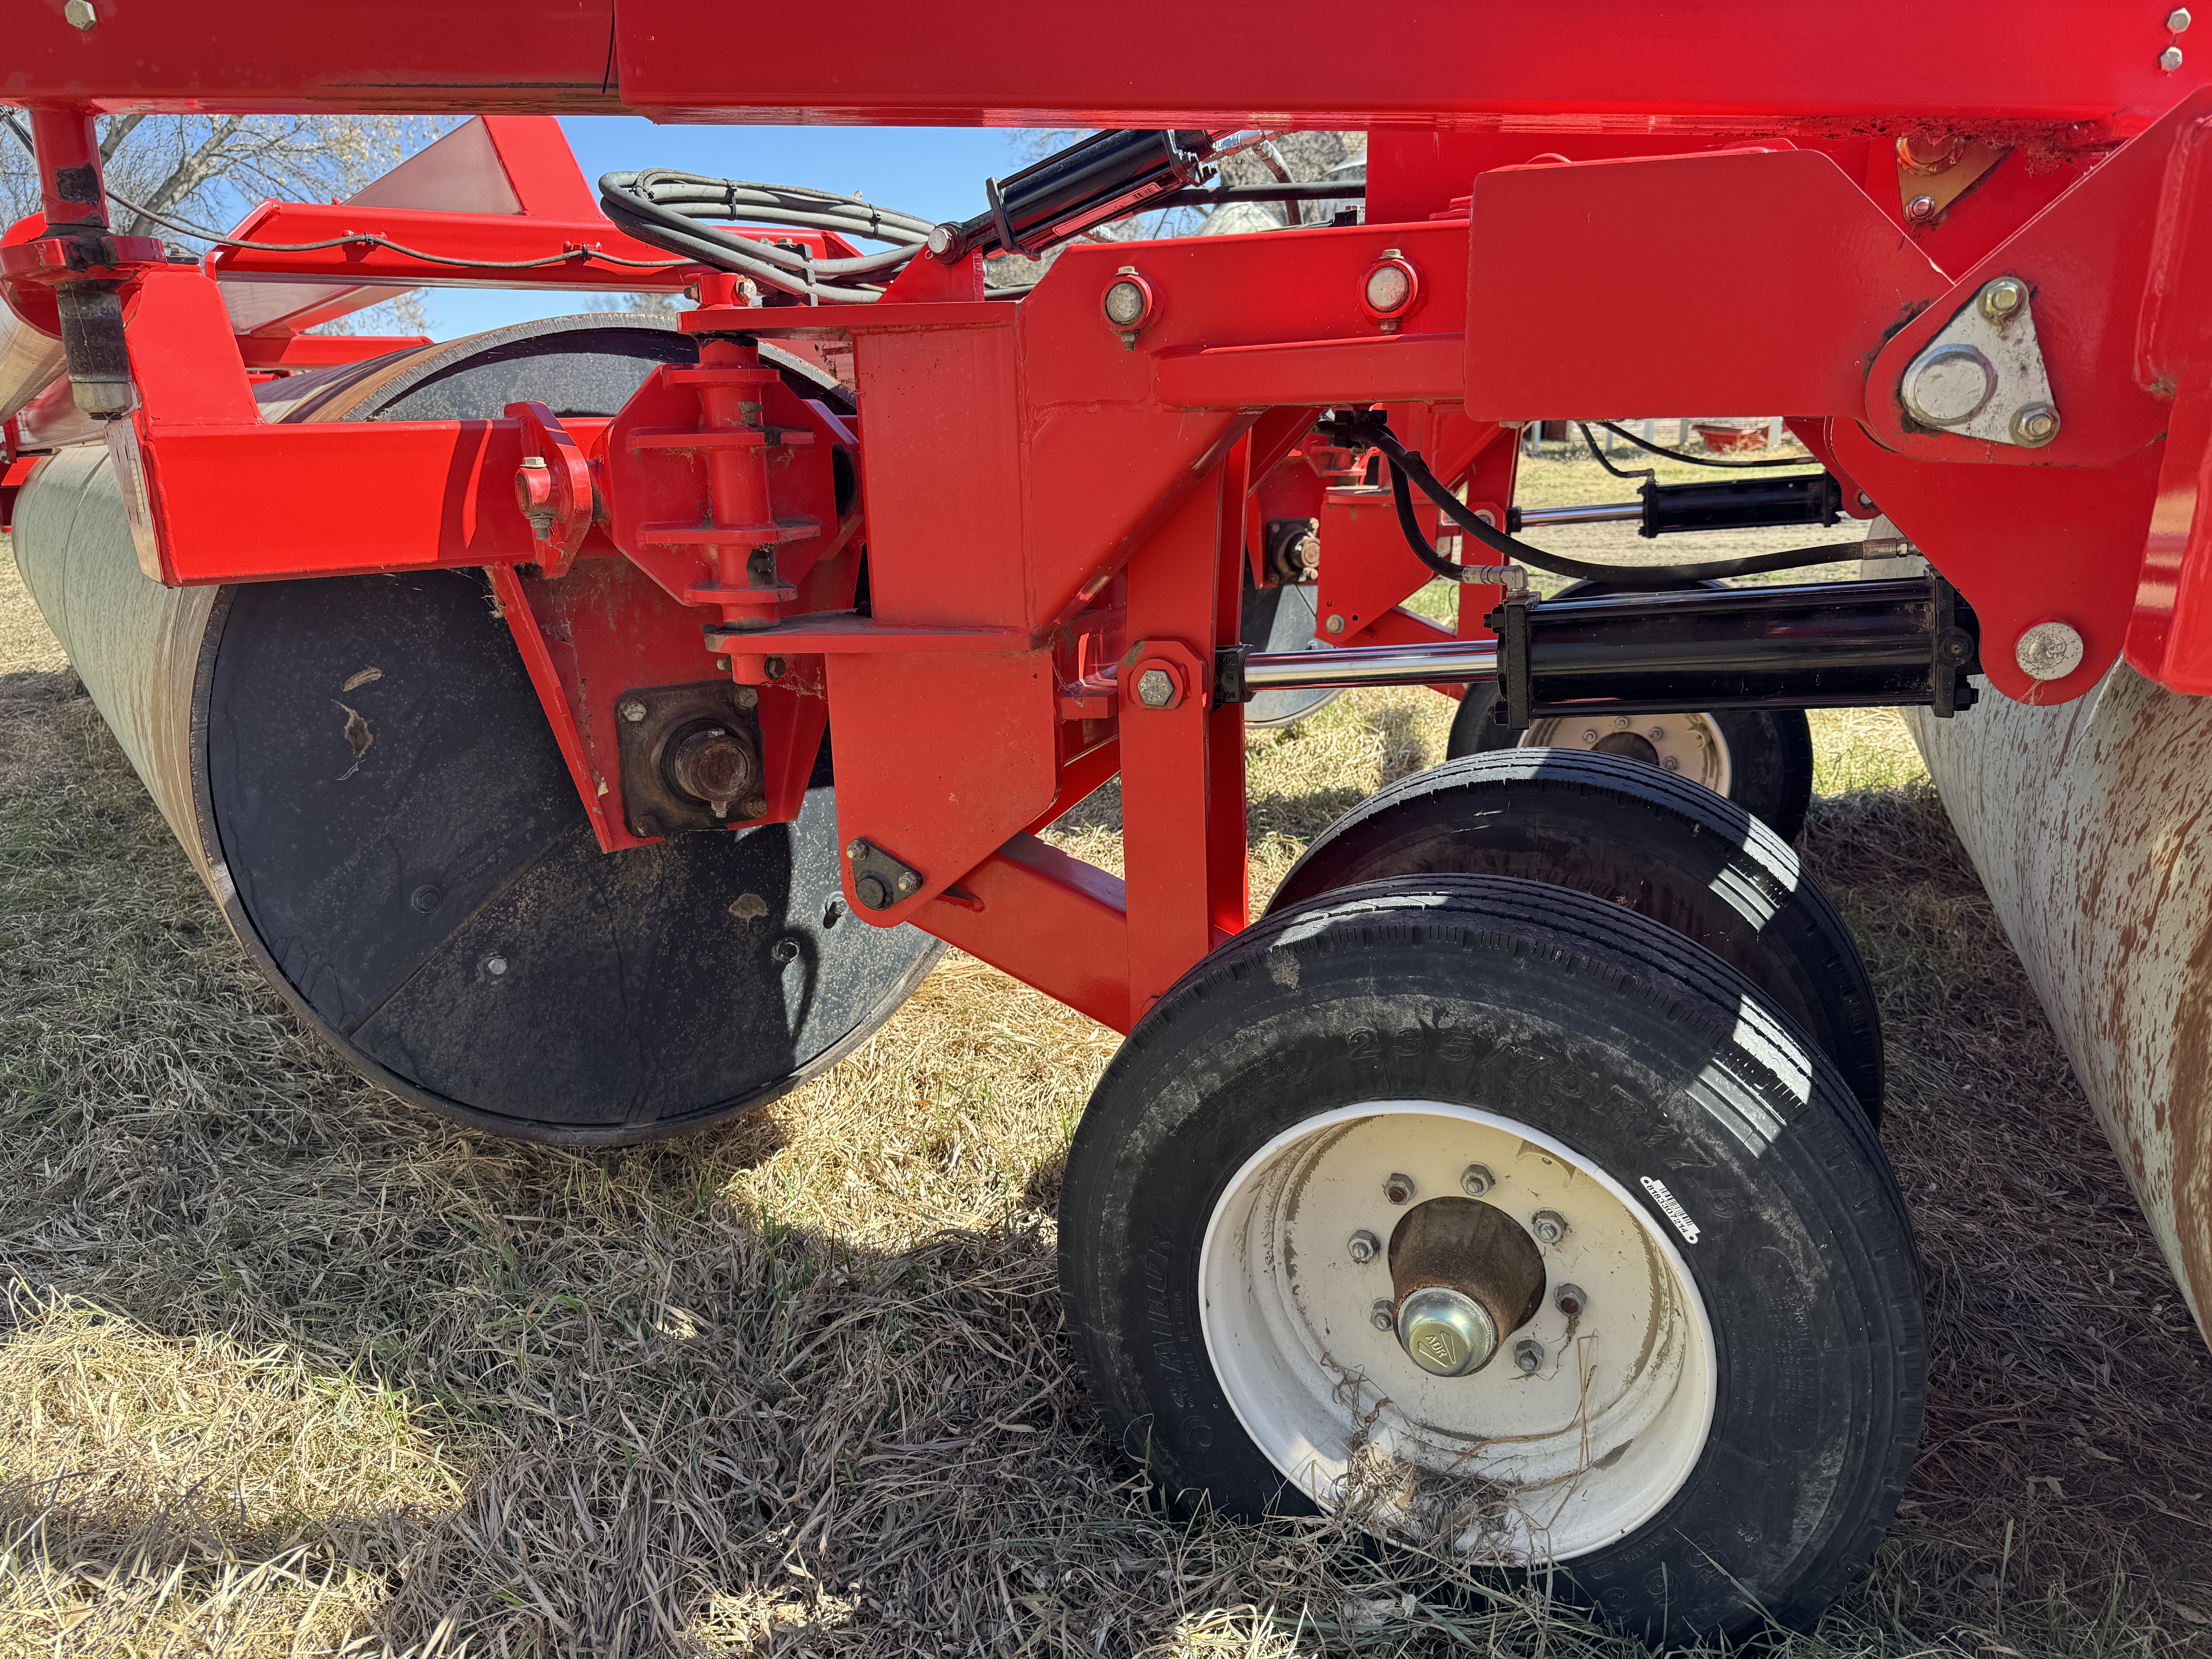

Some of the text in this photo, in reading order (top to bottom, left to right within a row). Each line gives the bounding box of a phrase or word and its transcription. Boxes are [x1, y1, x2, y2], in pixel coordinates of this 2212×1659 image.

[1647, 1185, 1688, 1233] 8183307214
[1145, 1219, 1196, 1409] SAILUN
[1173, 1291, 1186, 1325] CHINA
[1425, 1335, 1448, 1358] ADR
